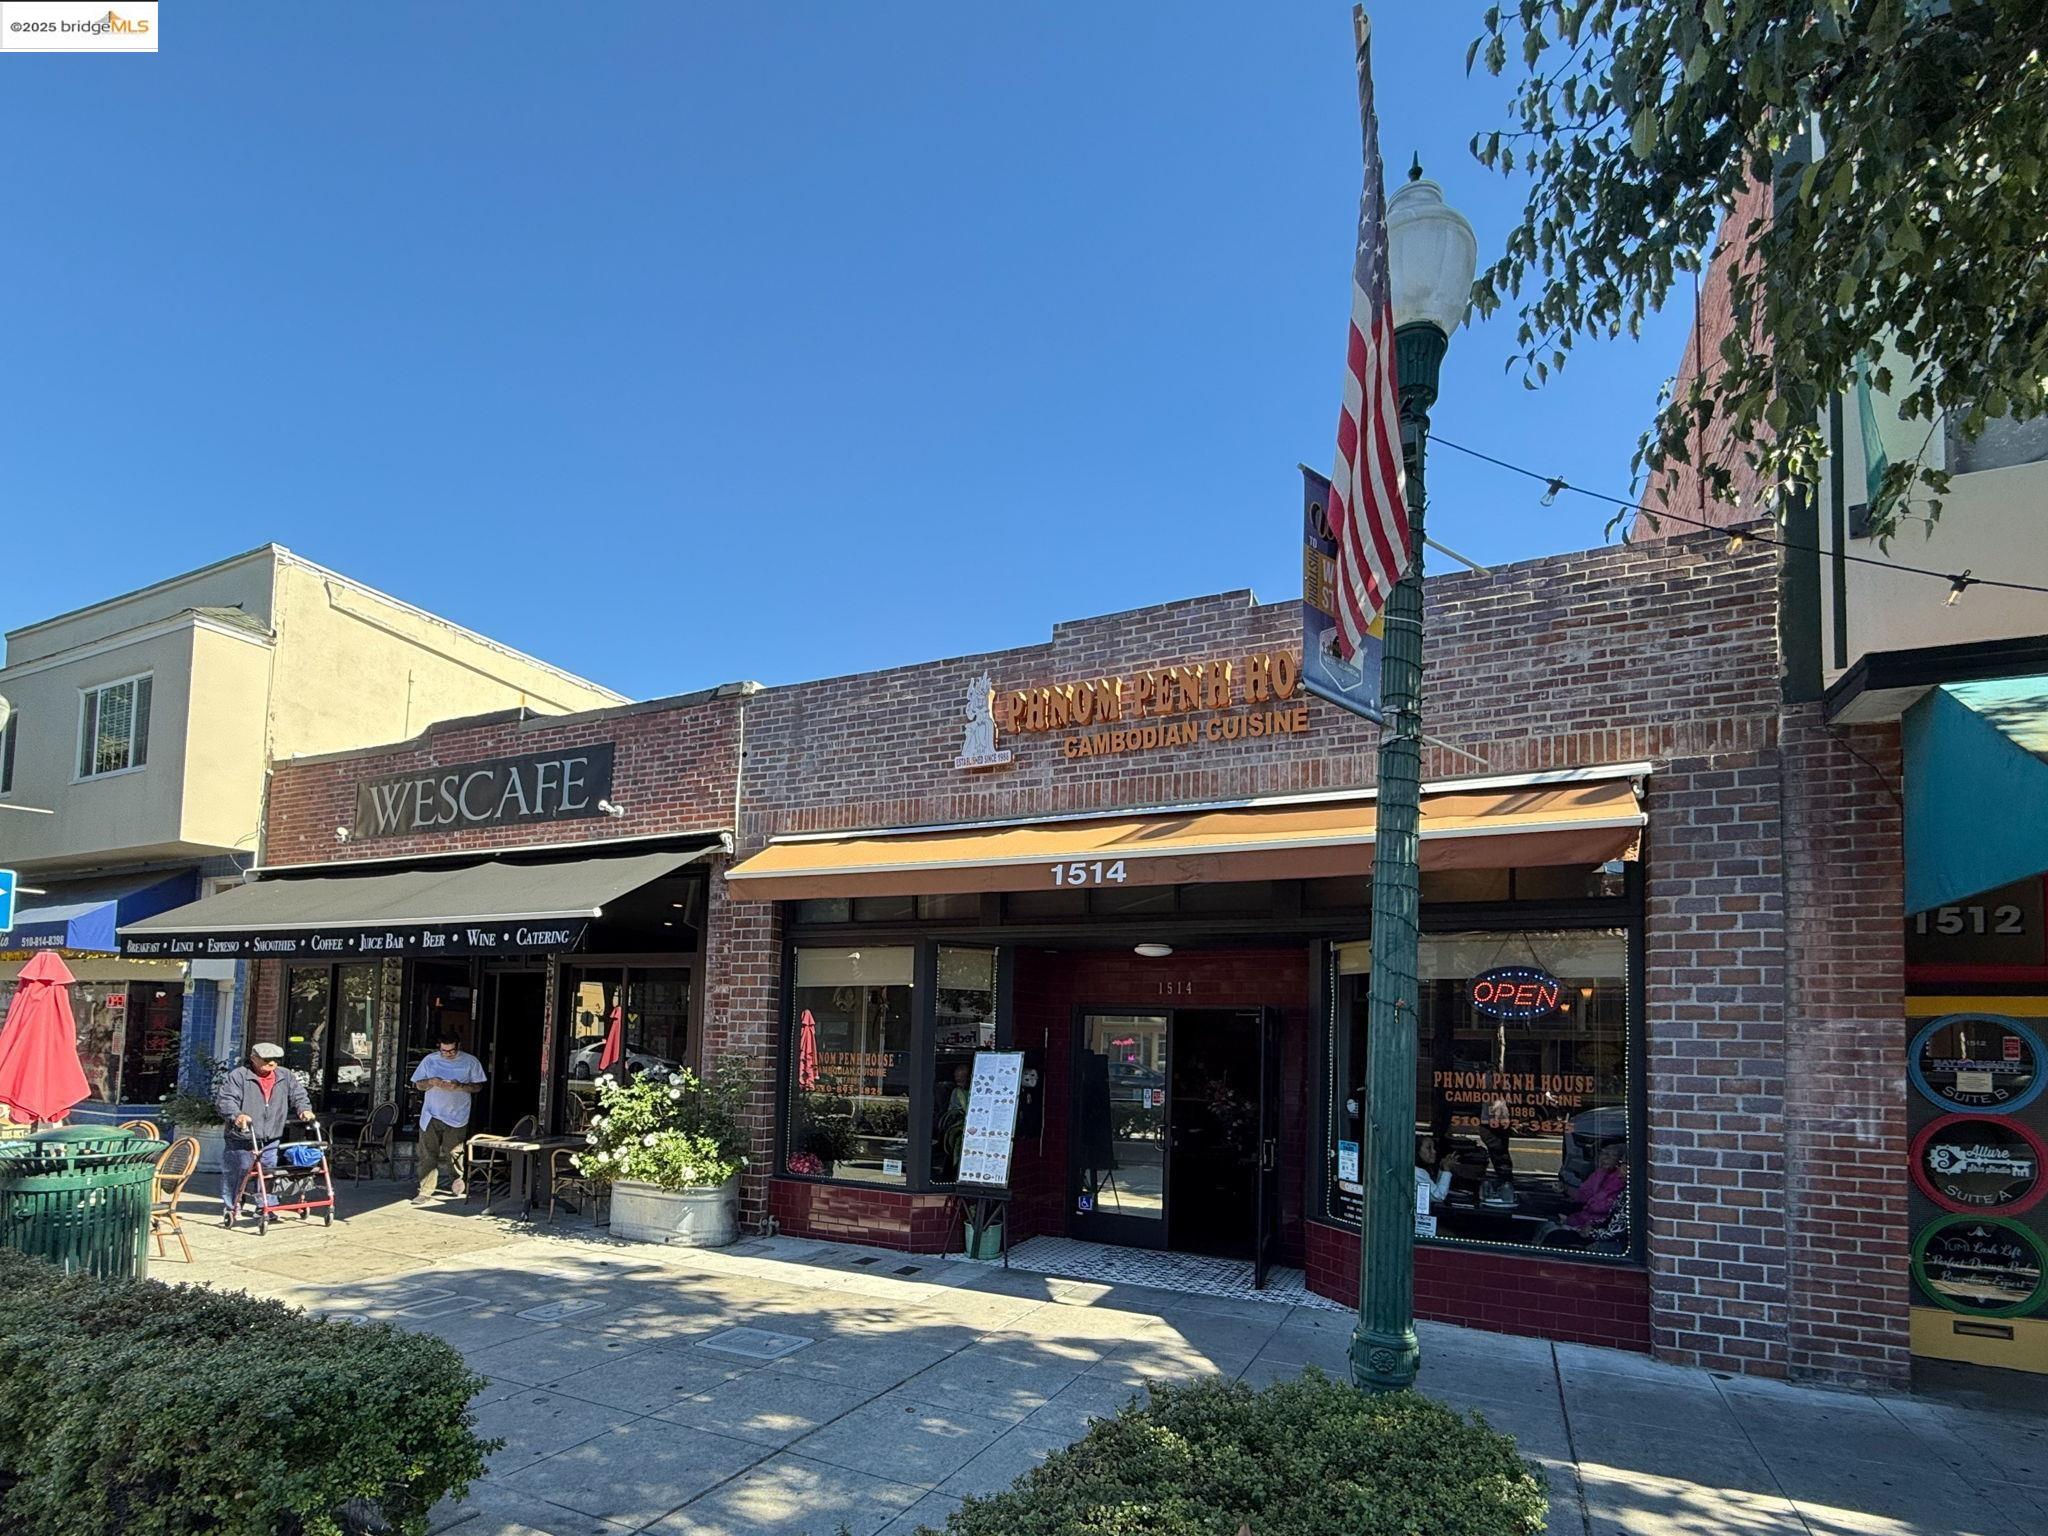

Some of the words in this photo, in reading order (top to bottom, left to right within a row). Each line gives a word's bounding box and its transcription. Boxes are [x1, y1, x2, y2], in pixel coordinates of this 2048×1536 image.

[1308, 547, 1320, 608] HISTORIC
[1006, 676, 1123, 734] PHNOM
[1134, 661, 1233, 717] PENH
[1244, 650, 1297, 704] HO
[1063, 722, 1199, 759] CAMBODIAN
[1205, 707, 1309, 742] CUISINE
[370, 756, 589, 835] WESCAFE
[1050, 860, 1127, 886] 1514
[1915, 904, 2022, 935] 1512
[171, 938, 194, 952] LUNCH
[207, 938, 239, 953] ESPRESSO
[253, 936, 296, 952] SMOOTHIES
[311, 934, 344, 951] COFFEE
[358, 933, 383, 952] JUICE
[385, 932, 404, 949] BAR
[422, 930, 446, 948] BEER
[466, 928, 496, 947] WINE
[515, 927, 570, 946] CATERING
[1159, 981, 1192, 995] 1514
[1474, 981, 1559, 1008] OPEN
[1433, 1070, 1487, 1089] PHNOM
[1492, 1072, 1535, 1092] PENH
[1540, 1074, 1596, 1094] HOUSE
[1942, 1086, 1991, 1103] SUITE
[1994, 1088, 2009, 1100] B
[1445, 1090, 1523, 1105] CAMBODIAN
[1966, 1144, 2010, 1159] Allure
[1944, 1184, 1995, 1204] SUITE
[1998, 1190, 2013, 1201] A
